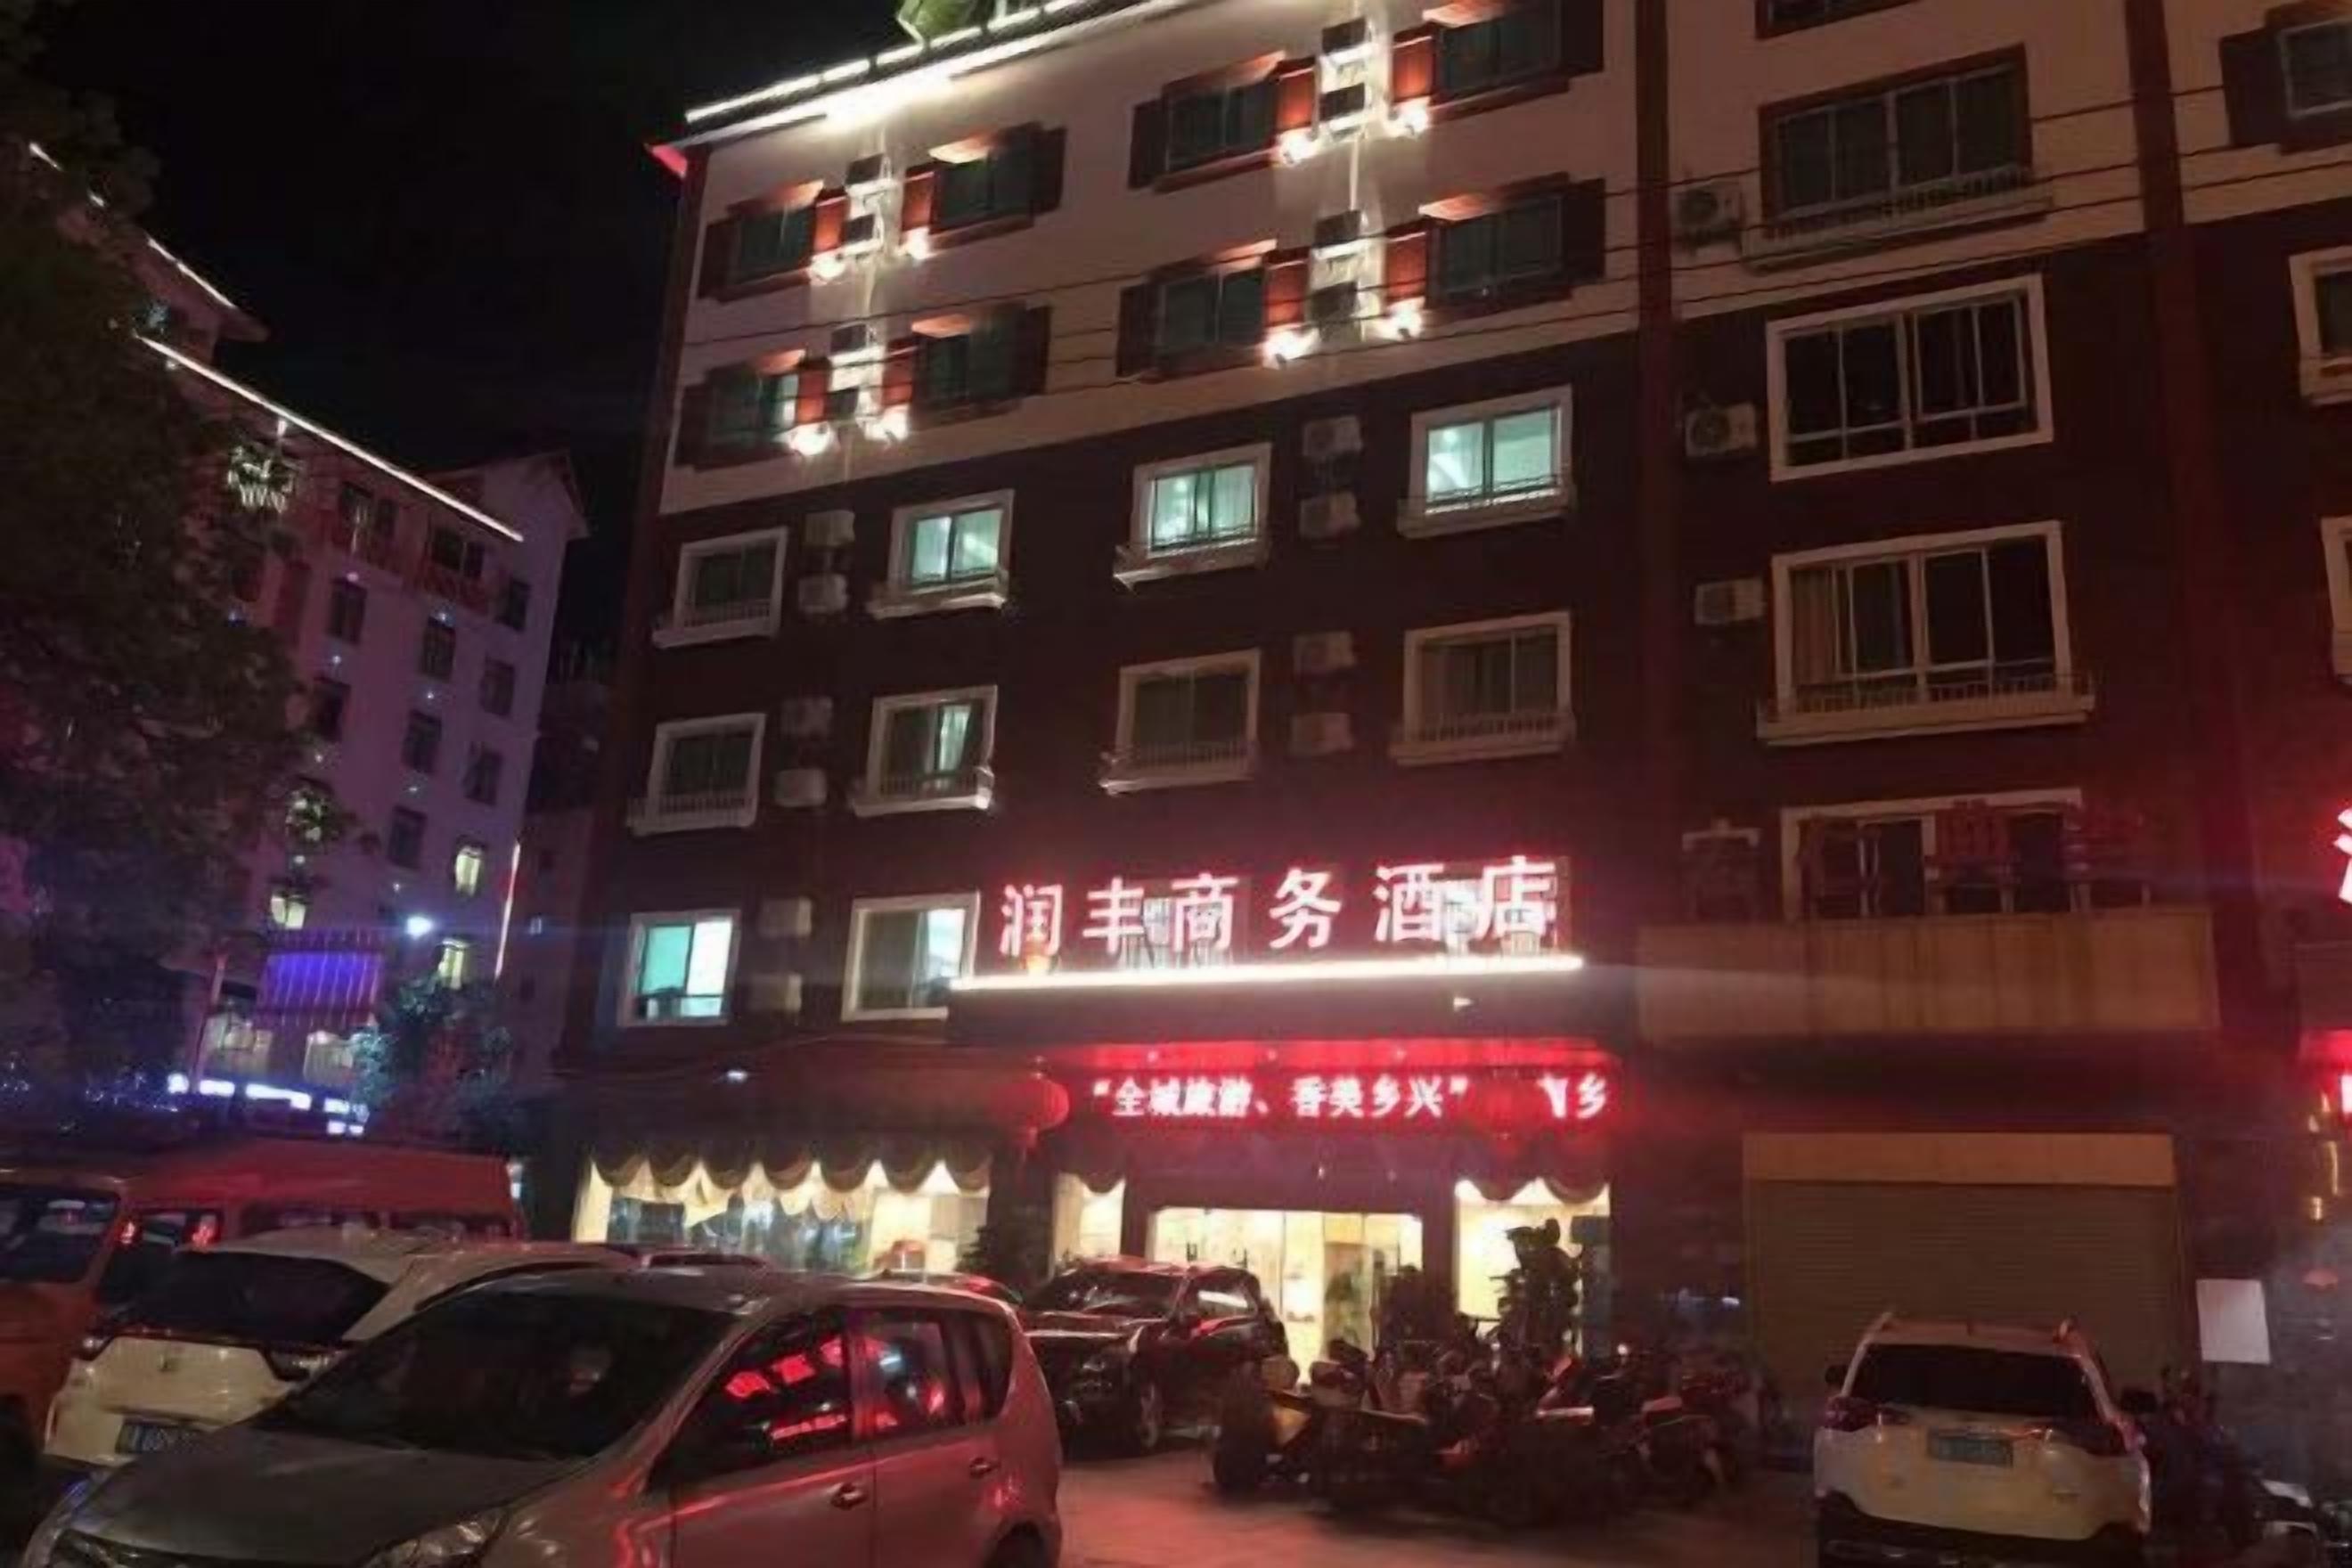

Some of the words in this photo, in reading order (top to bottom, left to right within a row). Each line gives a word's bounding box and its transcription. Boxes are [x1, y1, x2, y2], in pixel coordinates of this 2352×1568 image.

[999, 855, 1556, 957] 润丰商务酒店
